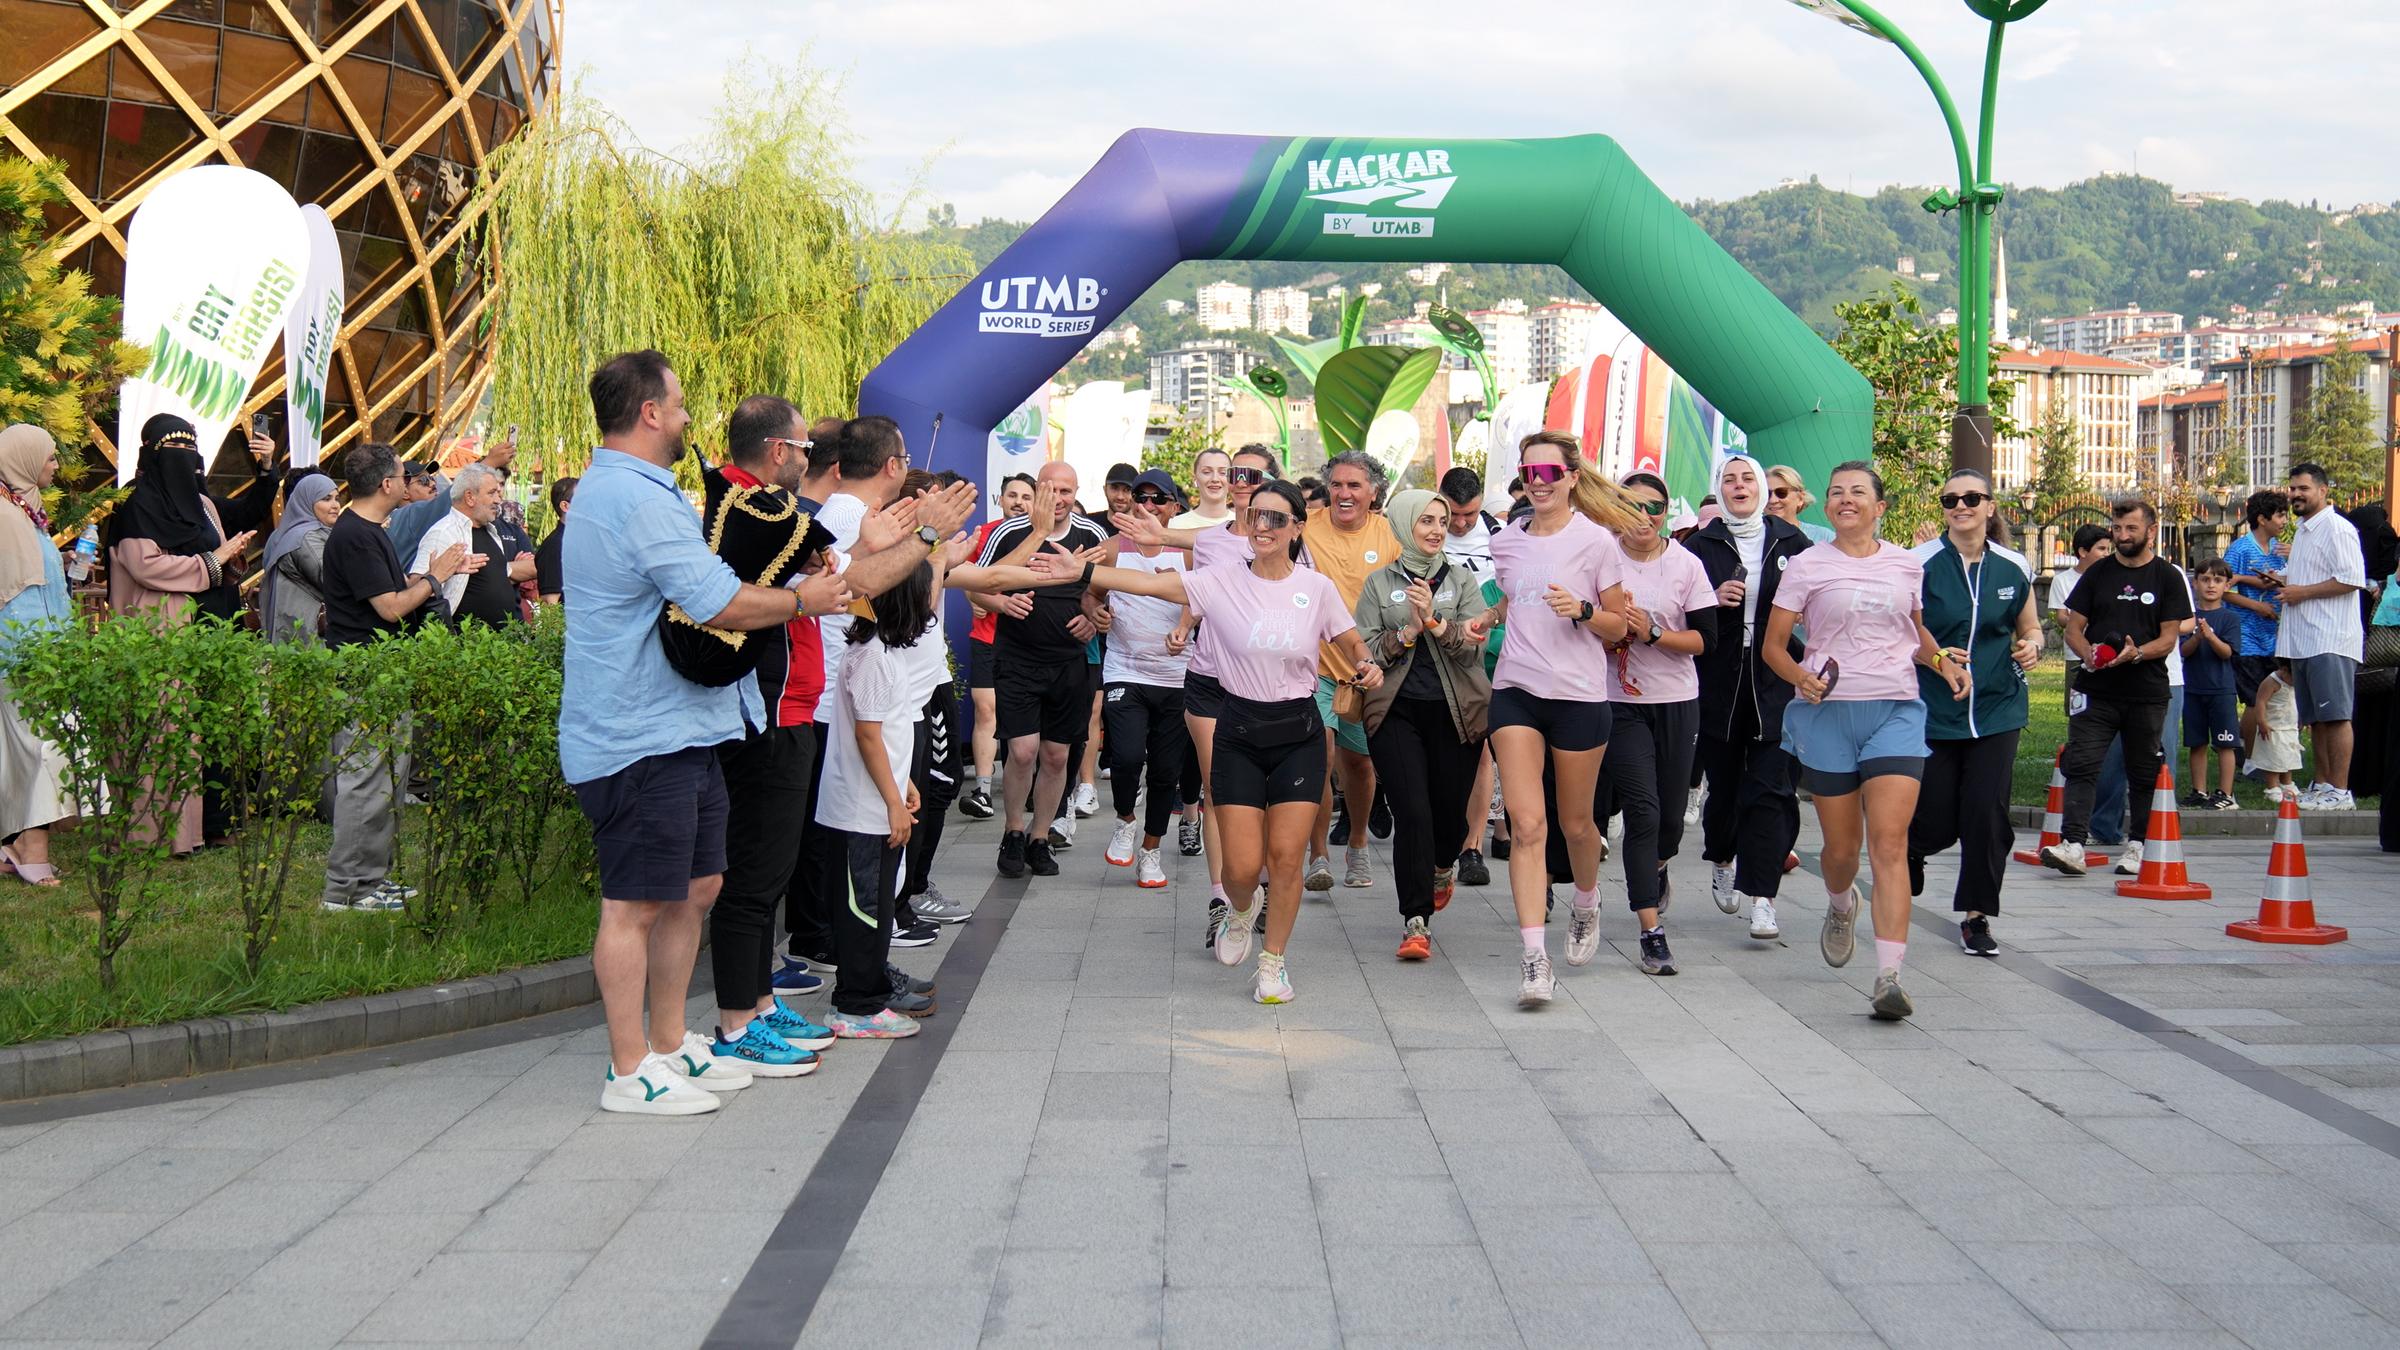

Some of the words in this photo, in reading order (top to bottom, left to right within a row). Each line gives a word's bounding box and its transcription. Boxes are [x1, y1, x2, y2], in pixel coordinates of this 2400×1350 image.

[1307, 149, 1453, 188] KAÇKAR
[1332, 218, 1352, 230] BY
[1372, 221, 1422, 234] UTMB
[187, 283, 236, 342] ÇAY
[985, 316, 1042, 329] WORLD
[1048, 320, 1090, 333] SERIES
[2217, 730, 2234, 741] alo
[734, 1046, 765, 1061] HOKA
